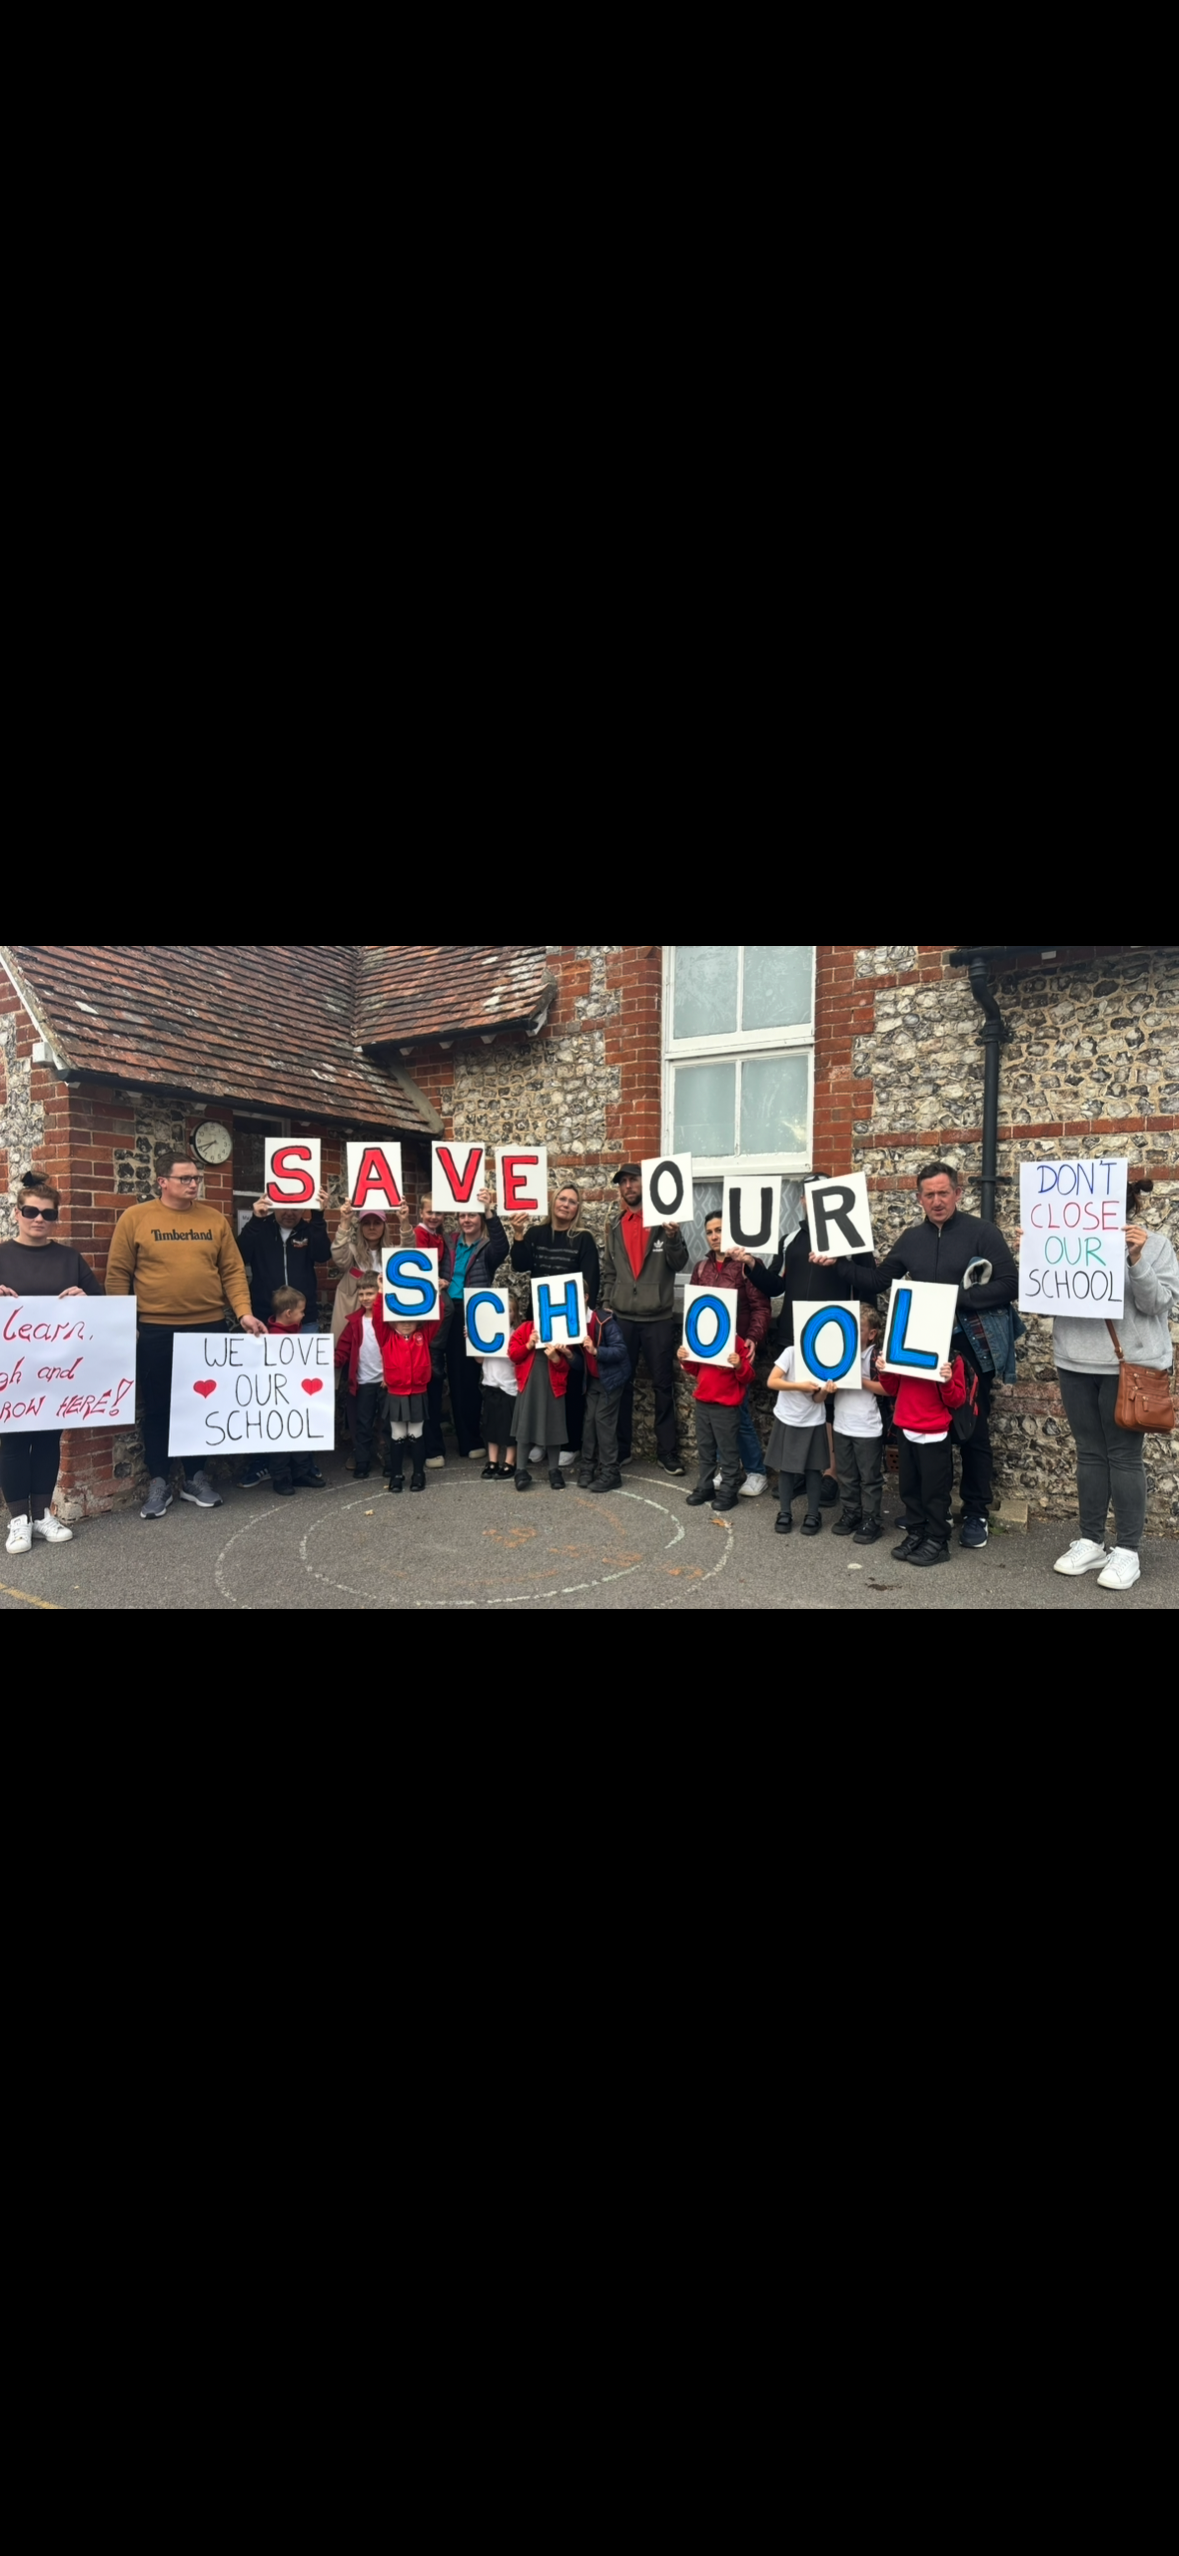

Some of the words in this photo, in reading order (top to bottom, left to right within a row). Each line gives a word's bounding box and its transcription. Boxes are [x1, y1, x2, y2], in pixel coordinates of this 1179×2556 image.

[1037, 1160, 1117, 1196] DON'T
[1030, 1200, 1120, 1231] CLOSE
[150, 1228, 213, 1242] Timberland
[1044, 1235, 1107, 1267] OUR
[1025, 1268, 1123, 1302] SCHOOL
[204, 1337, 244, 1367] WE
[264, 1337, 330, 1366] LOVE
[37, 1356, 84, 1382] and
[56, 1378, 135, 1420] HERE!
[235, 1373, 290, 1407] OUR
[205, 1408, 324, 1446] SCHOOL
